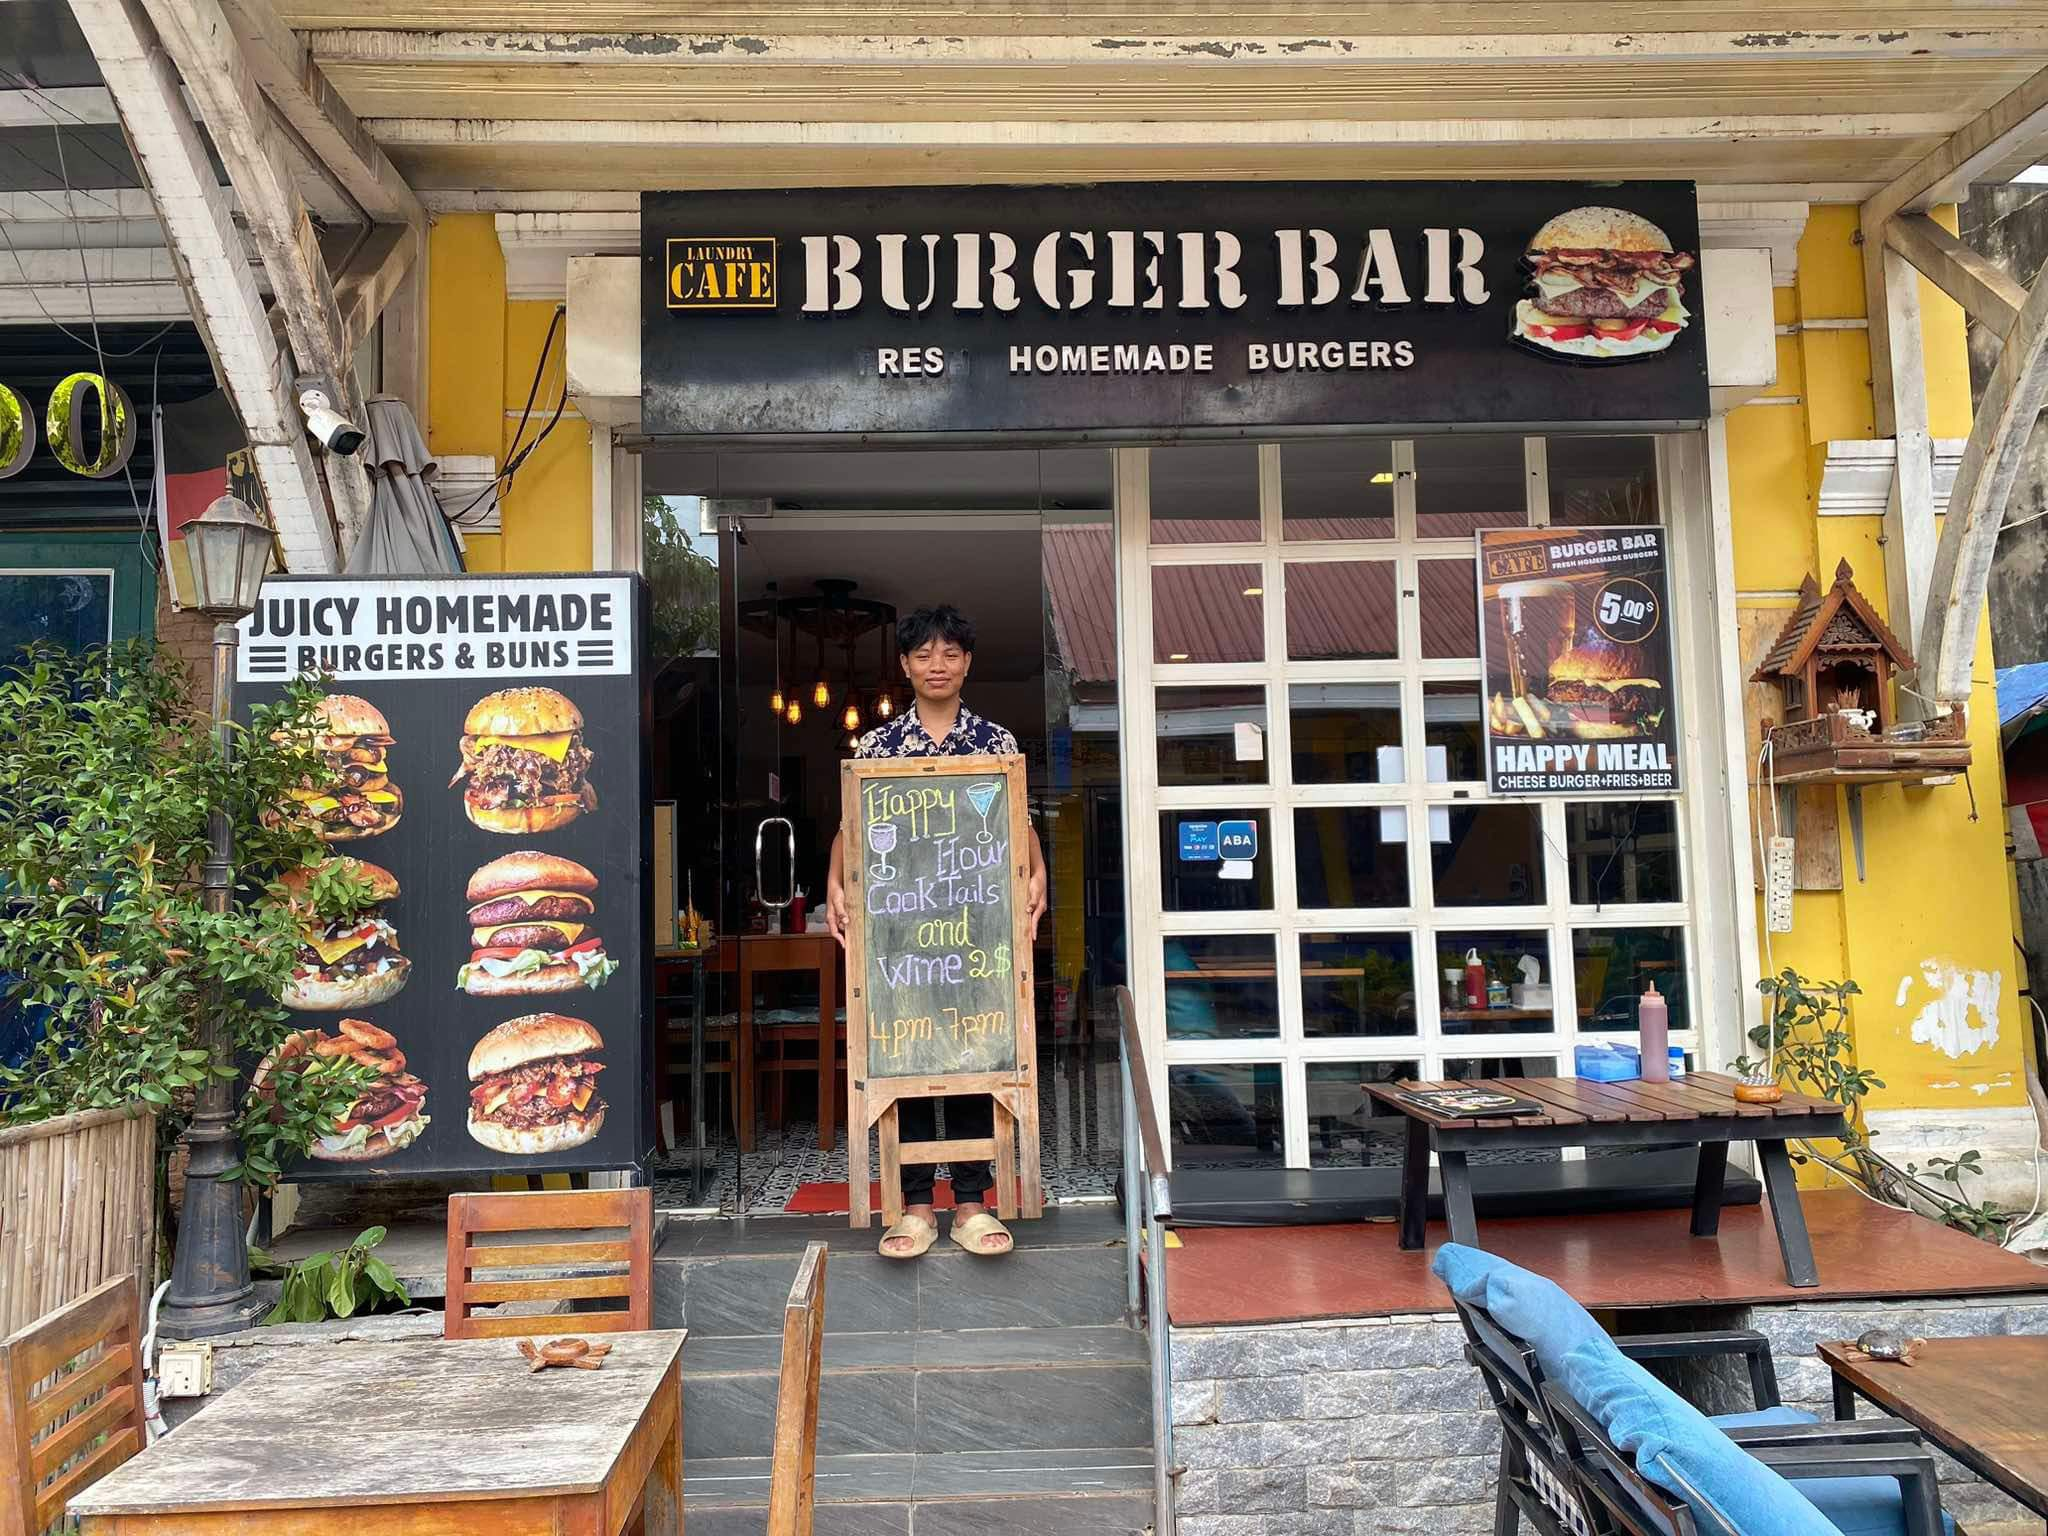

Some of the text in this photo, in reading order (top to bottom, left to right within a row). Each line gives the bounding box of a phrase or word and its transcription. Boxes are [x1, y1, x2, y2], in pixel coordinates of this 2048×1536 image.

[687, 246, 753, 260] LAUNDRY
[671, 262, 771, 299] CAFE
[801, 228, 1490, 312] BURGER BAR
[878, 340, 1415, 374] RES HOMEMADE BURGERS
[1550, 533, 1657, 559] BURGER BAR
[1552, 550, 1659, 569] FRESH HOMEMADE BURGERS
[1491, 555, 1545, 576] CAFE
[249, 593, 612, 637] JUICY HOMEMADE
[297, 640, 570, 672] BURGERS & BUNS
[1496, 743, 1672, 772] HAPPY MEAL
[1499, 774, 1547, 789] CHEESE
[863, 782, 957, 842] Happy
[933, 835, 1008, 876] Hour
[1223, 834, 1252, 846] ABA
[918, 905, 976, 948] and
